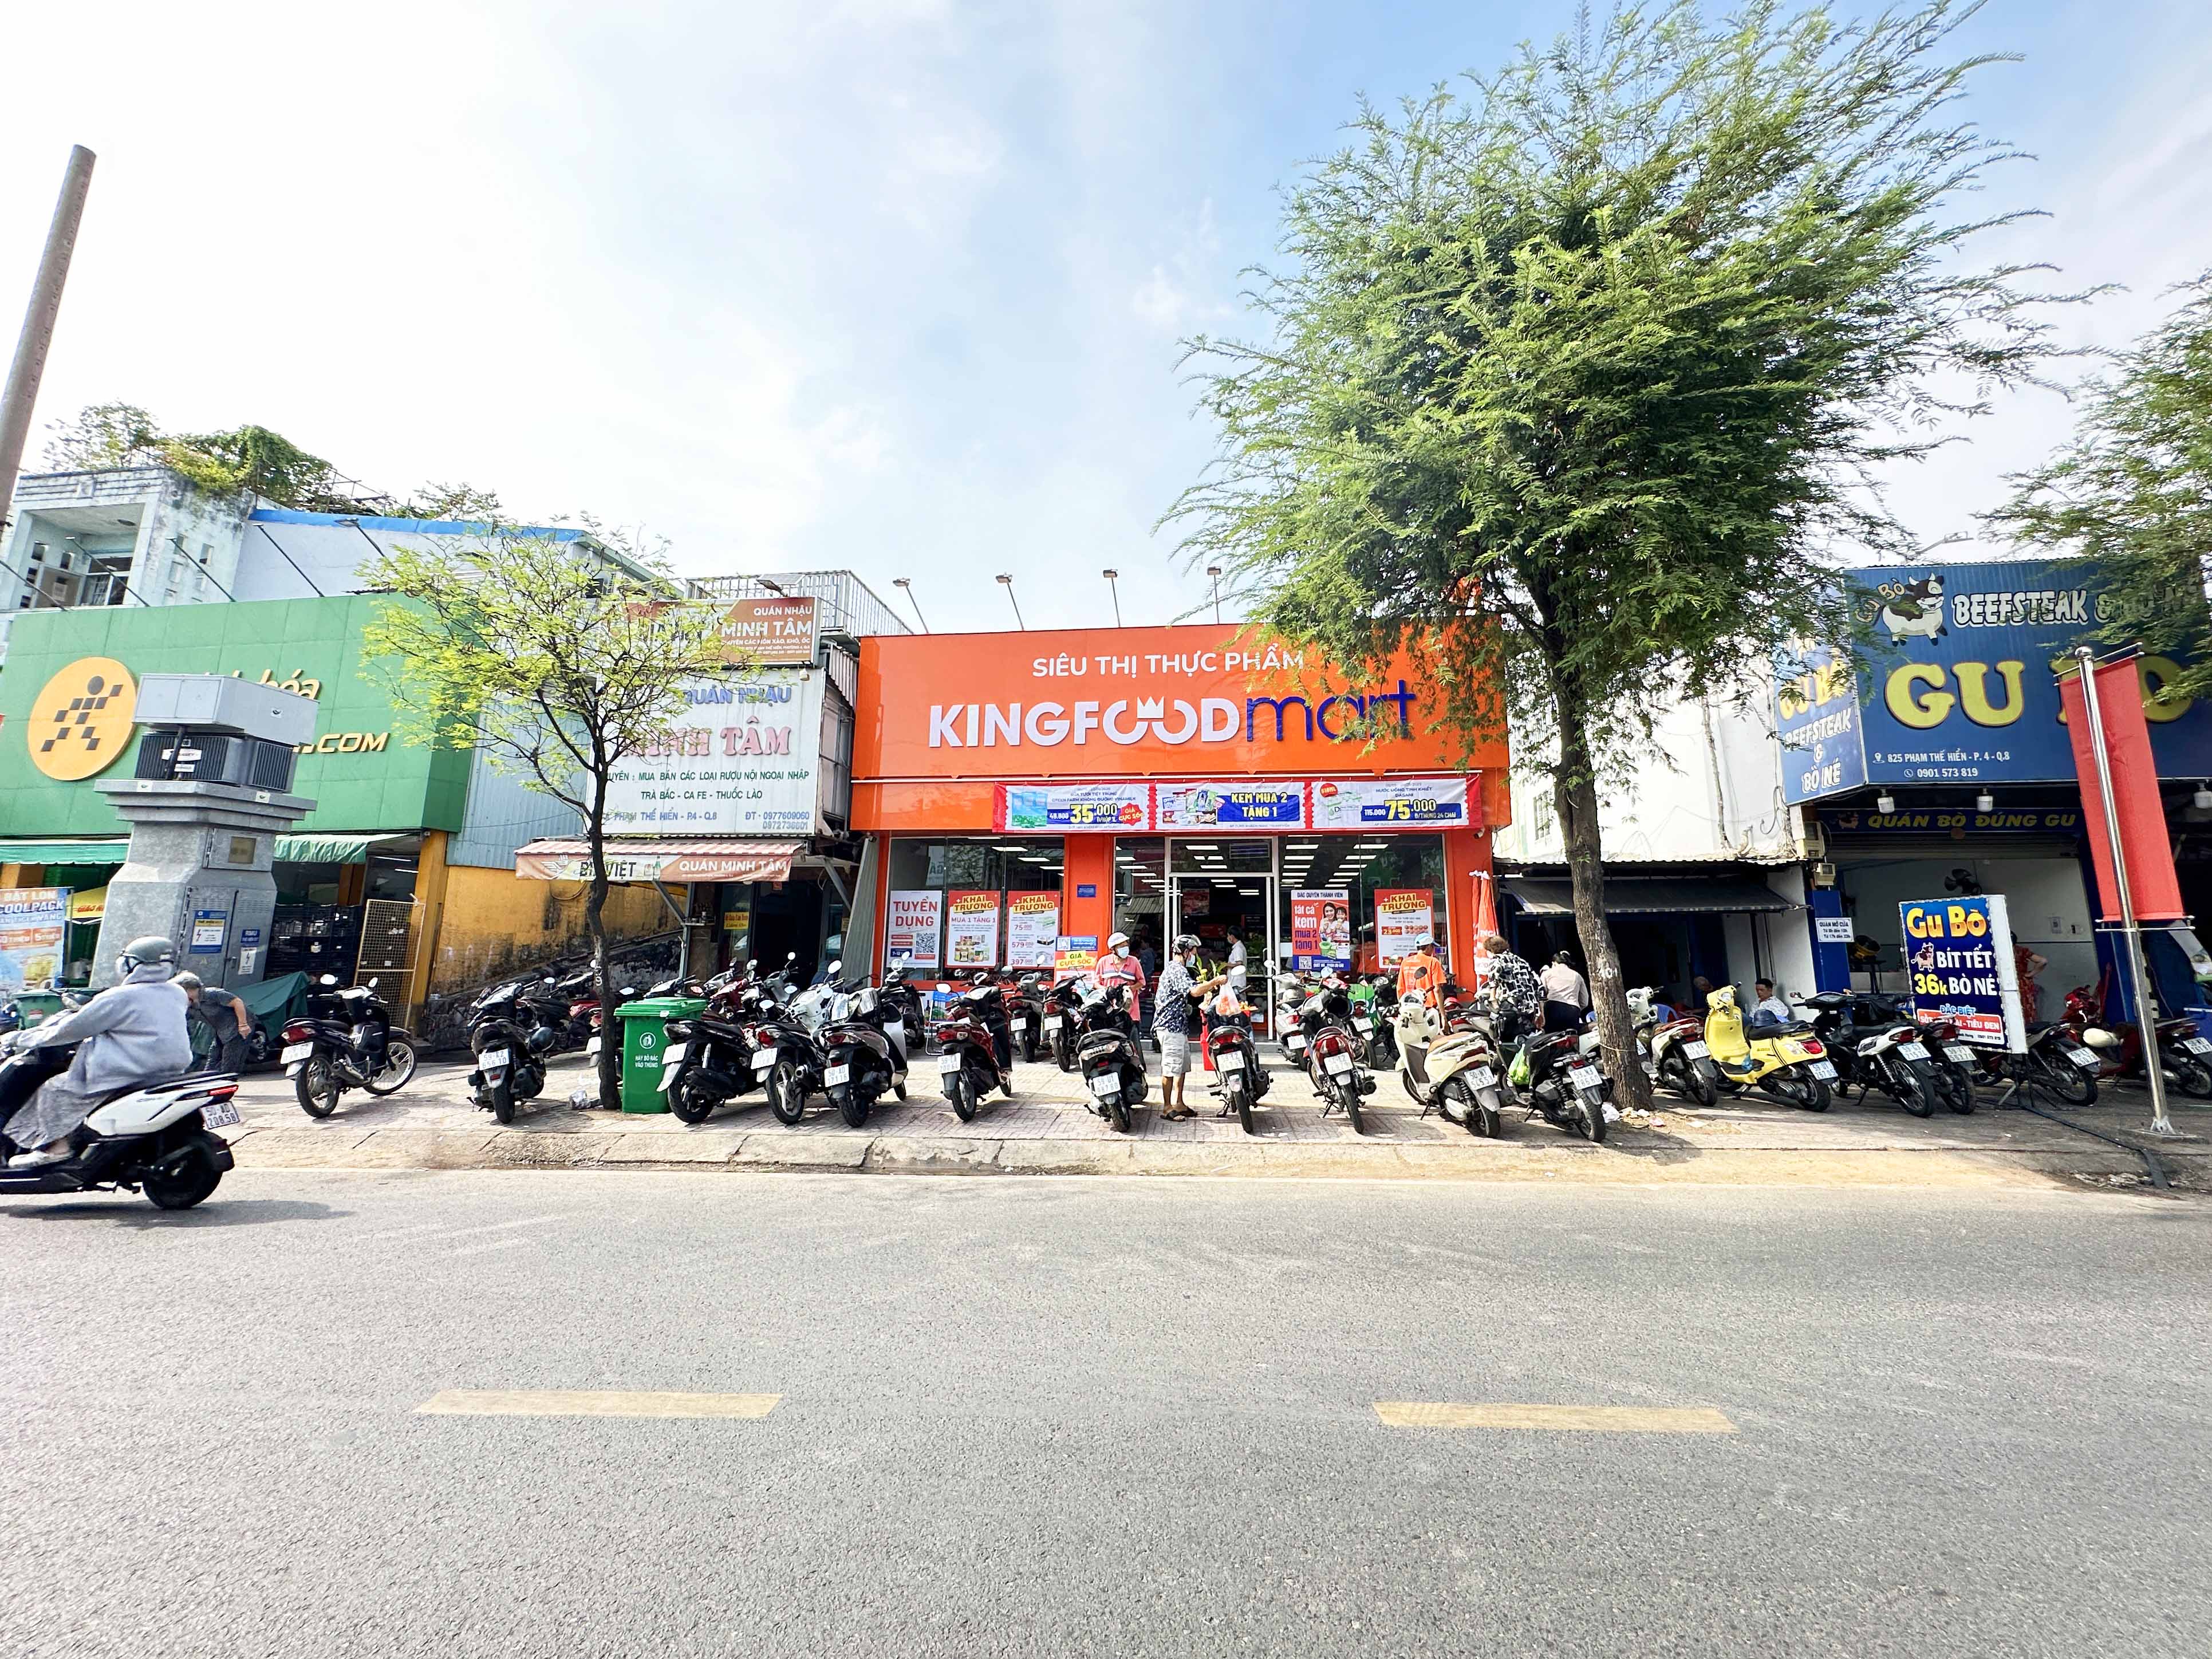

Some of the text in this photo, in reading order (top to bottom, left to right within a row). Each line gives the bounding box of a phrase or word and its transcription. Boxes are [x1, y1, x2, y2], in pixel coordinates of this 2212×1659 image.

[1876, 577, 1906, 600] BÒ
[754, 605, 813, 616] QUÁN NHẬU
[1952, 589, 2089, 628] BEEFSTEAK
[721, 617, 812, 637] MINH TÂM
[1032, 643, 1304, 679] SIÊU THỊ THỰC PHẨM
[1884, 660, 2025, 729] GU
[720, 716, 792, 756] TÂM
[1887, 753, 1903, 763] 825
[1905, 753, 1927, 764] PHẠM
[1929, 749, 1946, 762] THẾ
[1947, 748, 1967, 762] HIỂN
[1996, 751, 2010, 762] Q.8
[608, 769, 809, 783] UYÊN MUA BÁN CÁC LOẠI RƯỢU NỘI NGOẠI NHẬP
[1802, 757, 1841, 794] BÒ NÉ
[1917, 768, 1978, 778] 0901 573 819
[641, 789, 656, 799] TRÀ
[684, 791, 695, 799] CA
[697, 791, 707, 799] FE
[716, 786, 743, 799] THUỐC
[747, 789, 763, 799] LÀO
[1231, 792, 1288, 803] KEM MUA 2
[641, 808, 657, 821] THẾ
[660, 807, 678, 821] HIỂN
[1242, 805, 1278, 820] TẶNG 1
[1868, 811, 2076, 829] QUÁN BÒ ĐÚNG GU
[679, 859, 787, 871] QUÁN MINH TÂM
[893, 896, 938, 912] TUYỂN
[1023, 896, 1046, 904] KHAI
[1391, 894, 1415, 903] KHAI
[954, 902, 993, 911] TRƯƠNG
[1014, 902, 1054, 912] TRƯƠNG
[1382, 901, 1425, 911] TRƯƠNG
[895, 916, 935, 930] DỤNG
[1295, 916, 1317, 928] kem
[1906, 906, 1987, 939] Gu Bò
[1312, 930, 1317, 938] 2
[1936, 944, 1993, 968] BÍT TẾT
[1914, 973, 1998, 996] 36k BÒ NÉ
